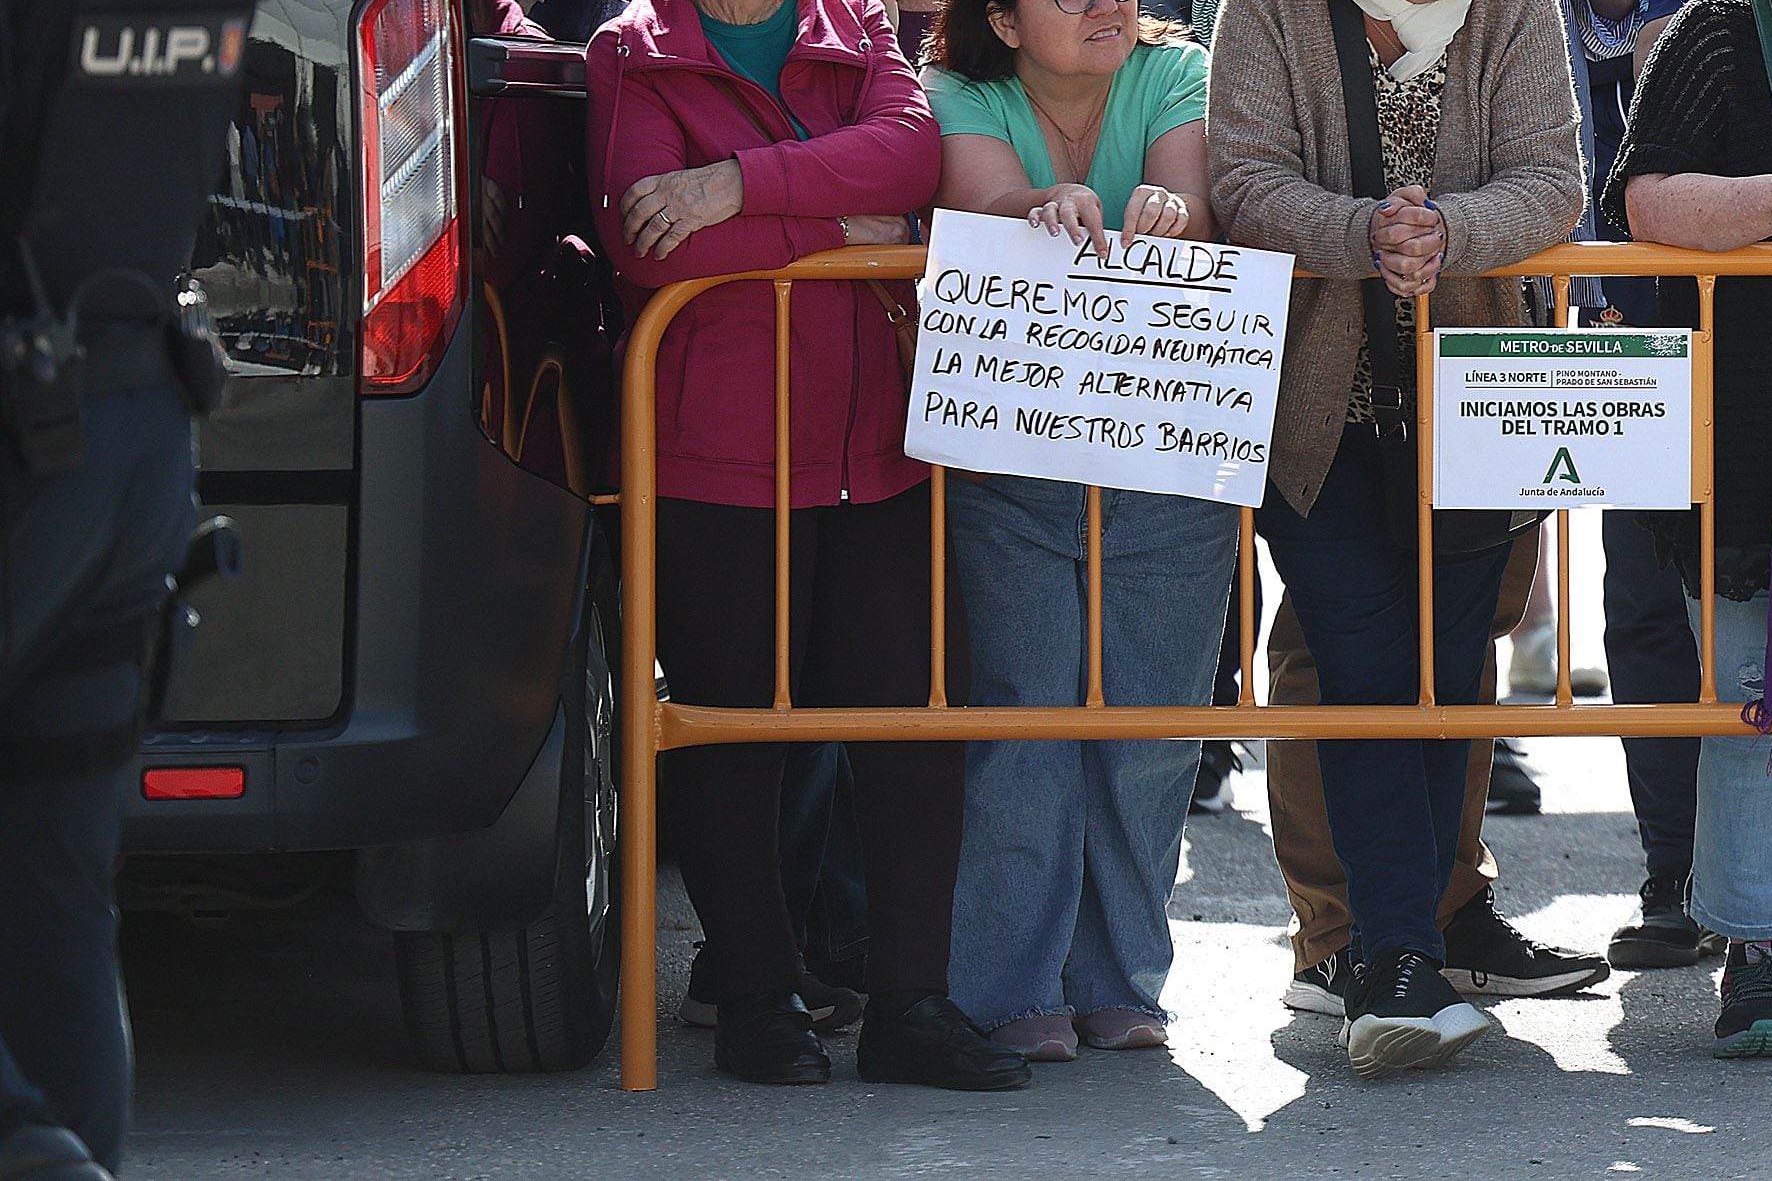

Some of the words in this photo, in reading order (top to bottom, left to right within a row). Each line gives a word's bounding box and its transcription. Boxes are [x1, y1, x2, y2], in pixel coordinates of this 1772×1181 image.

[81, 26, 216, 76] U.I.P.
[1073, 235, 1241, 282] ALCALDE
[935, 269, 1128, 323] QUEREMOS
[1148, 302, 1274, 337] SEGUIR
[1027, 322, 1146, 356] RECOGIDA
[1500, 340, 1549, 354] METRO
[1566, 340, 1623, 354] SEVILLA
[931, 348, 962, 375] LA
[975, 354, 1064, 390] MEJOR
[1079, 371, 1253, 413] ALTERNATIVA
[1465, 369, 1498, 383] LÍNEA
[1499, 372, 1506, 383] 3
[1508, 372, 1547, 383] NORTE
[1556, 370, 1576, 378] PINO
[1577, 370, 1618, 378] MONTANO
[1556, 378, 1584, 386] PRADO
[1585, 378, 1595, 386] DE
[1597, 378, 1613, 386] SAN
[1614, 377, 1657, 386] SEBASTIÁN
[1460, 401, 1557, 418] INICIAMOS
[1563, 401, 1597, 418] LAS
[1602, 401, 1666, 418] OBRAS
[925, 391, 998, 431] PARA
[1016, 408, 1145, 449] NUESTROS
[1156, 422, 1265, 464] BARRIOS
[1501, 420, 1536, 436] DEL
[1541, 420, 1610, 436] TRAMO
[1613, 420, 1624, 435] 1
[1519, 487, 1545, 497] Junta
[1547, 487, 1558, 496] de
[1560, 486, 1605, 496] Andalucía
